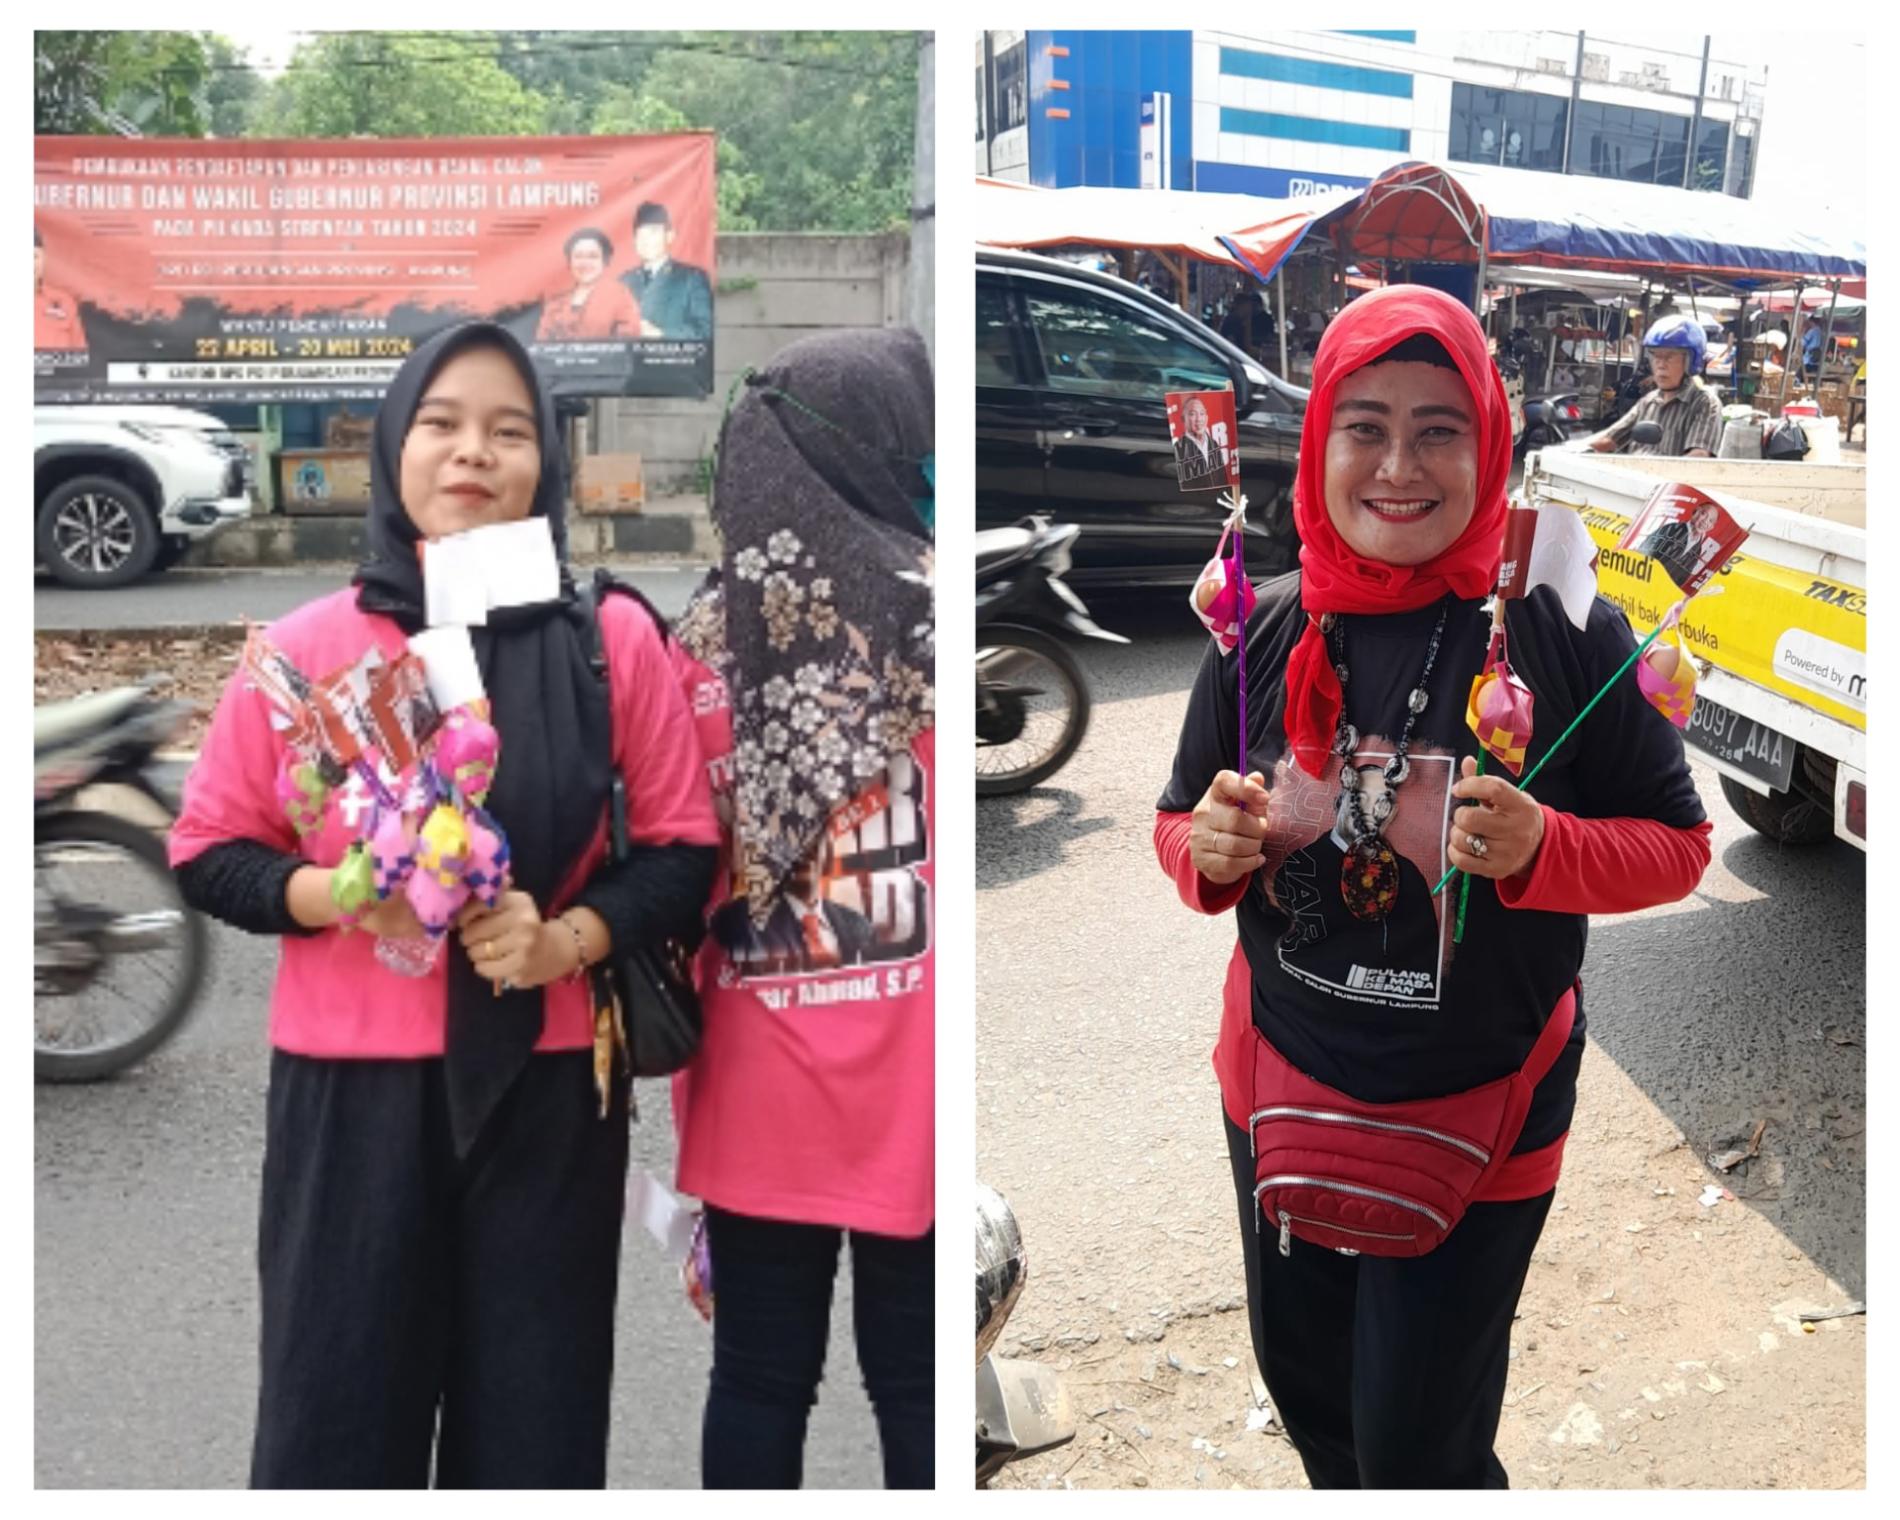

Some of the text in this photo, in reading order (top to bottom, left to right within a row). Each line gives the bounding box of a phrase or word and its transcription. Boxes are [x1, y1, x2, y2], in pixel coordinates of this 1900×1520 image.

[34, 181, 599, 210] UBERNUR DAN WAKIL GUBERNUR PROVINSI LAMPUNG
[153, 219, 195, 236] PADA
[432, 219, 478, 236] 2024
[224, 338, 278, 357] APRIL
[299, 338, 321, 356] 20
[365, 338, 413, 356] 2024
[1597, 546, 1654, 584] emudi
[1638, 598, 1661, 625] bak
[1676, 617, 1719, 650] rbuka
[1784, 649, 1829, 678] Powered
[1831, 667, 1845, 686] by
[1744, 722, 1783, 767] AAA
[1365, 975, 1435, 990] KE MASA
[1366, 968, 1431, 982] PULANG
[1363, 982, 1415, 996] DEPAN
[1333, 990, 1387, 1006] GUBERNUR
[1389, 1000, 1439, 1011] LAMPUNG
